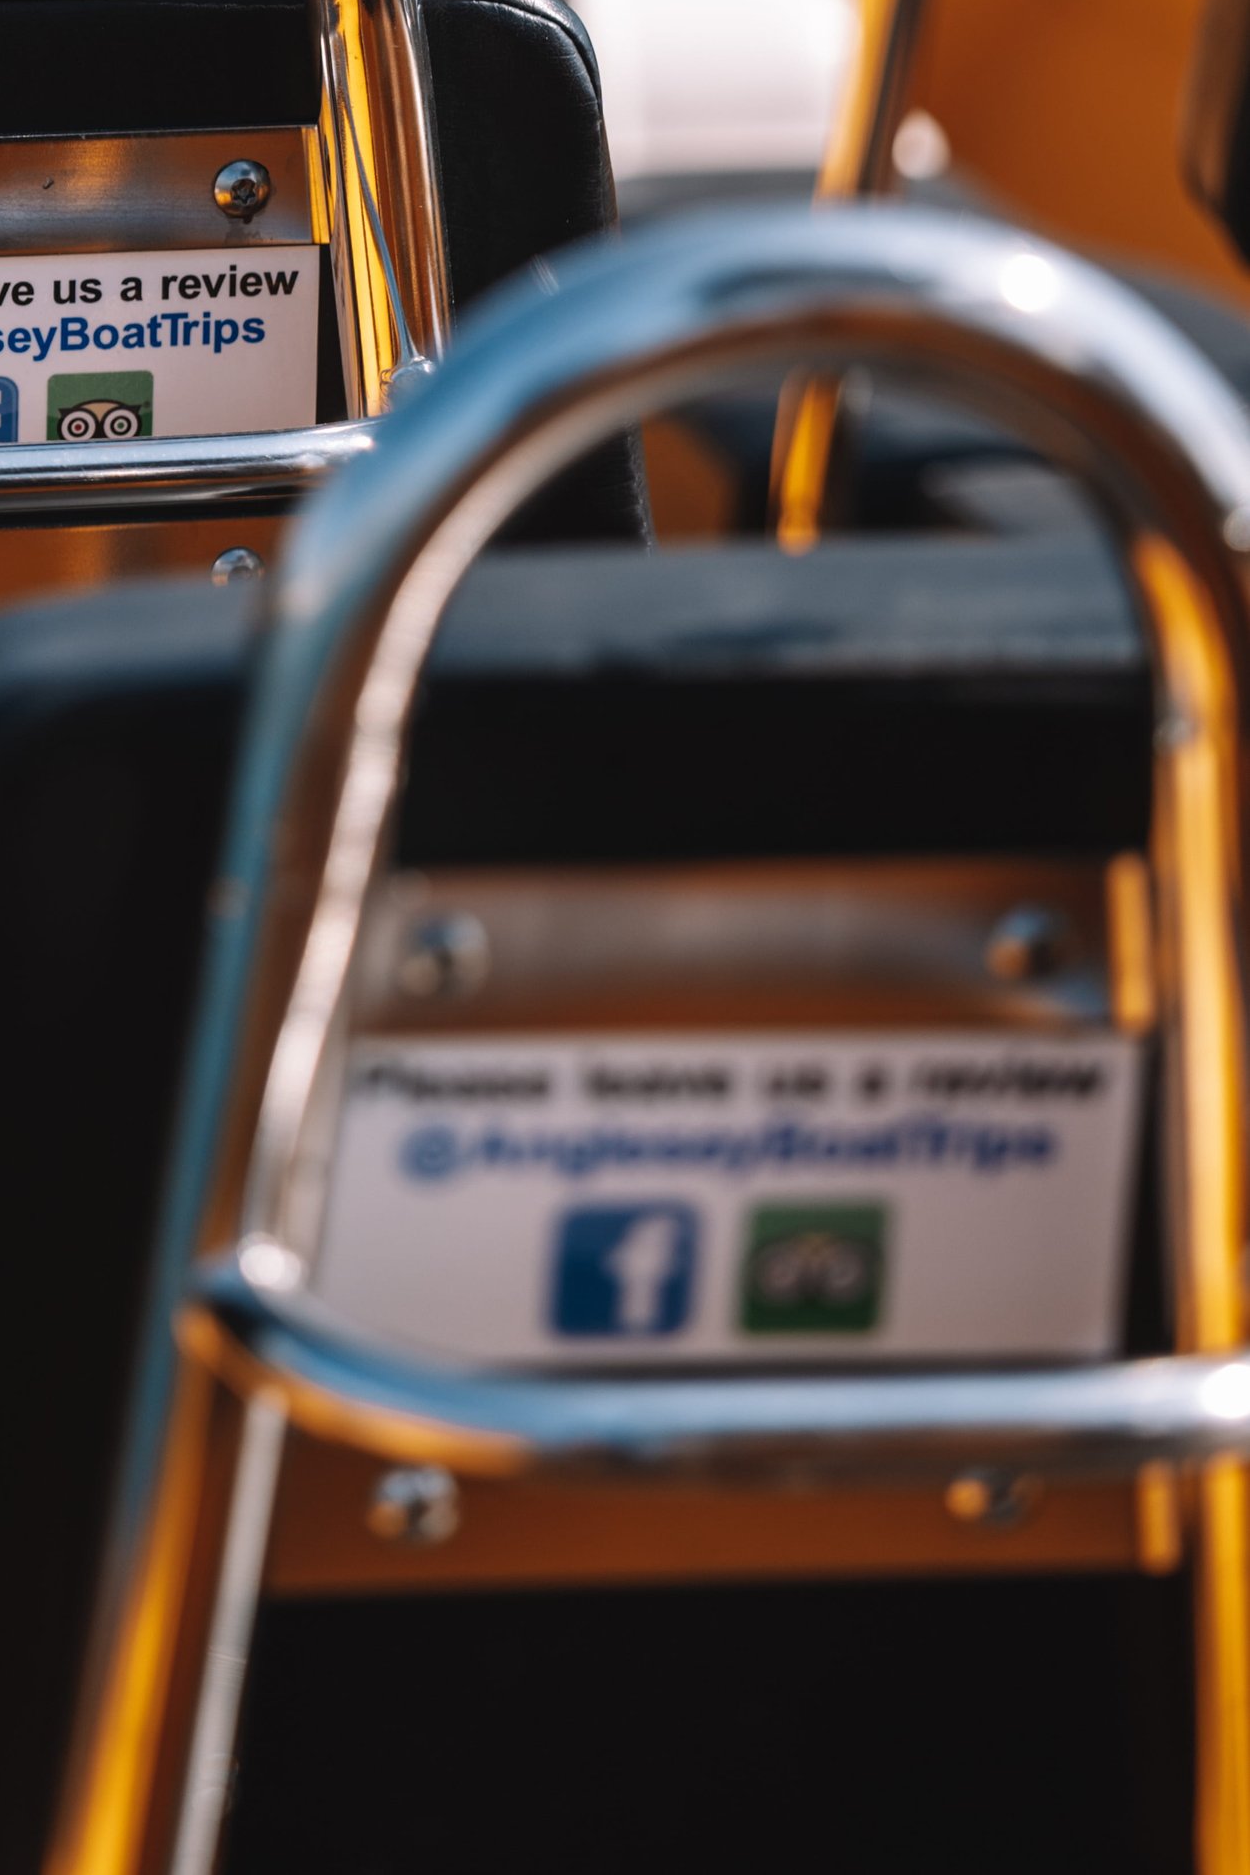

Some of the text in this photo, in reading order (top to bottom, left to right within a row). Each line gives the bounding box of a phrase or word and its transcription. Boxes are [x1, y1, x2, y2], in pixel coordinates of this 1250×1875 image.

[53, 278, 102, 304] us
[120, 277, 143, 301] a
[161, 265, 298, 300] review
[582, 1057, 732, 1102] leave
[913, 1055, 1104, 1101] review
